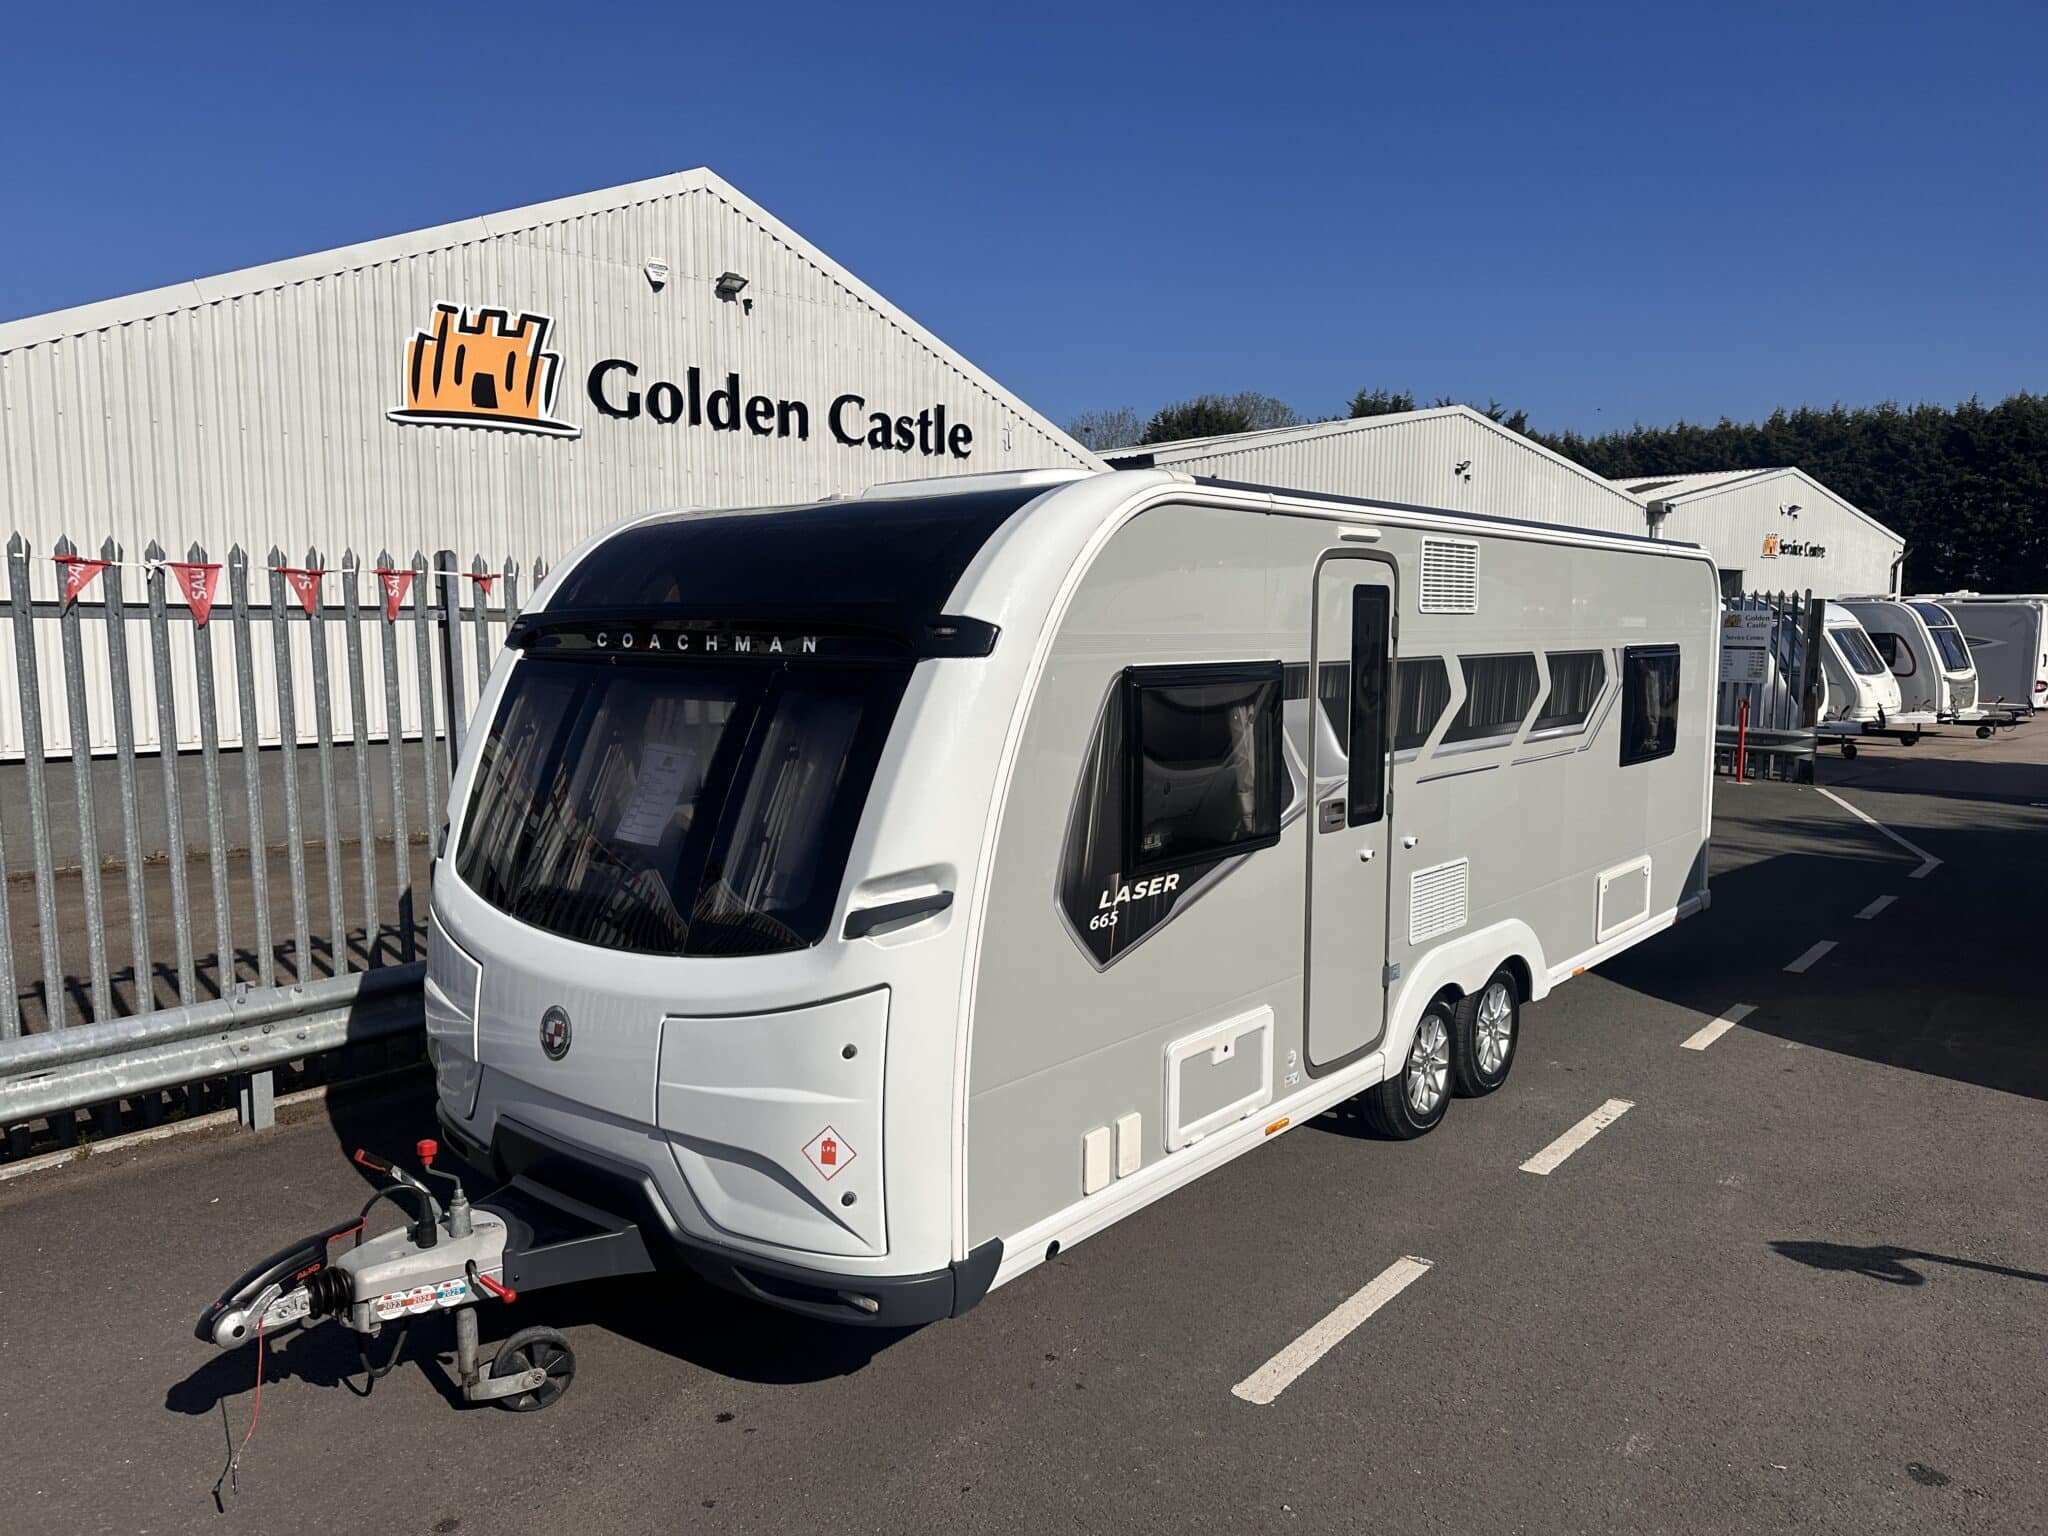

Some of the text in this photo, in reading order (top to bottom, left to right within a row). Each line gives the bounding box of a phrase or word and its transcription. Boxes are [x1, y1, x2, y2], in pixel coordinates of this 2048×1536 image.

[587, 359, 973, 458] Golden Castle
[1779, 538, 1826, 559] Service Centre
[596, 632, 817, 653] COACHMAN
[1098, 873, 1180, 909] LASER
[1089, 911, 1119, 931] 665
